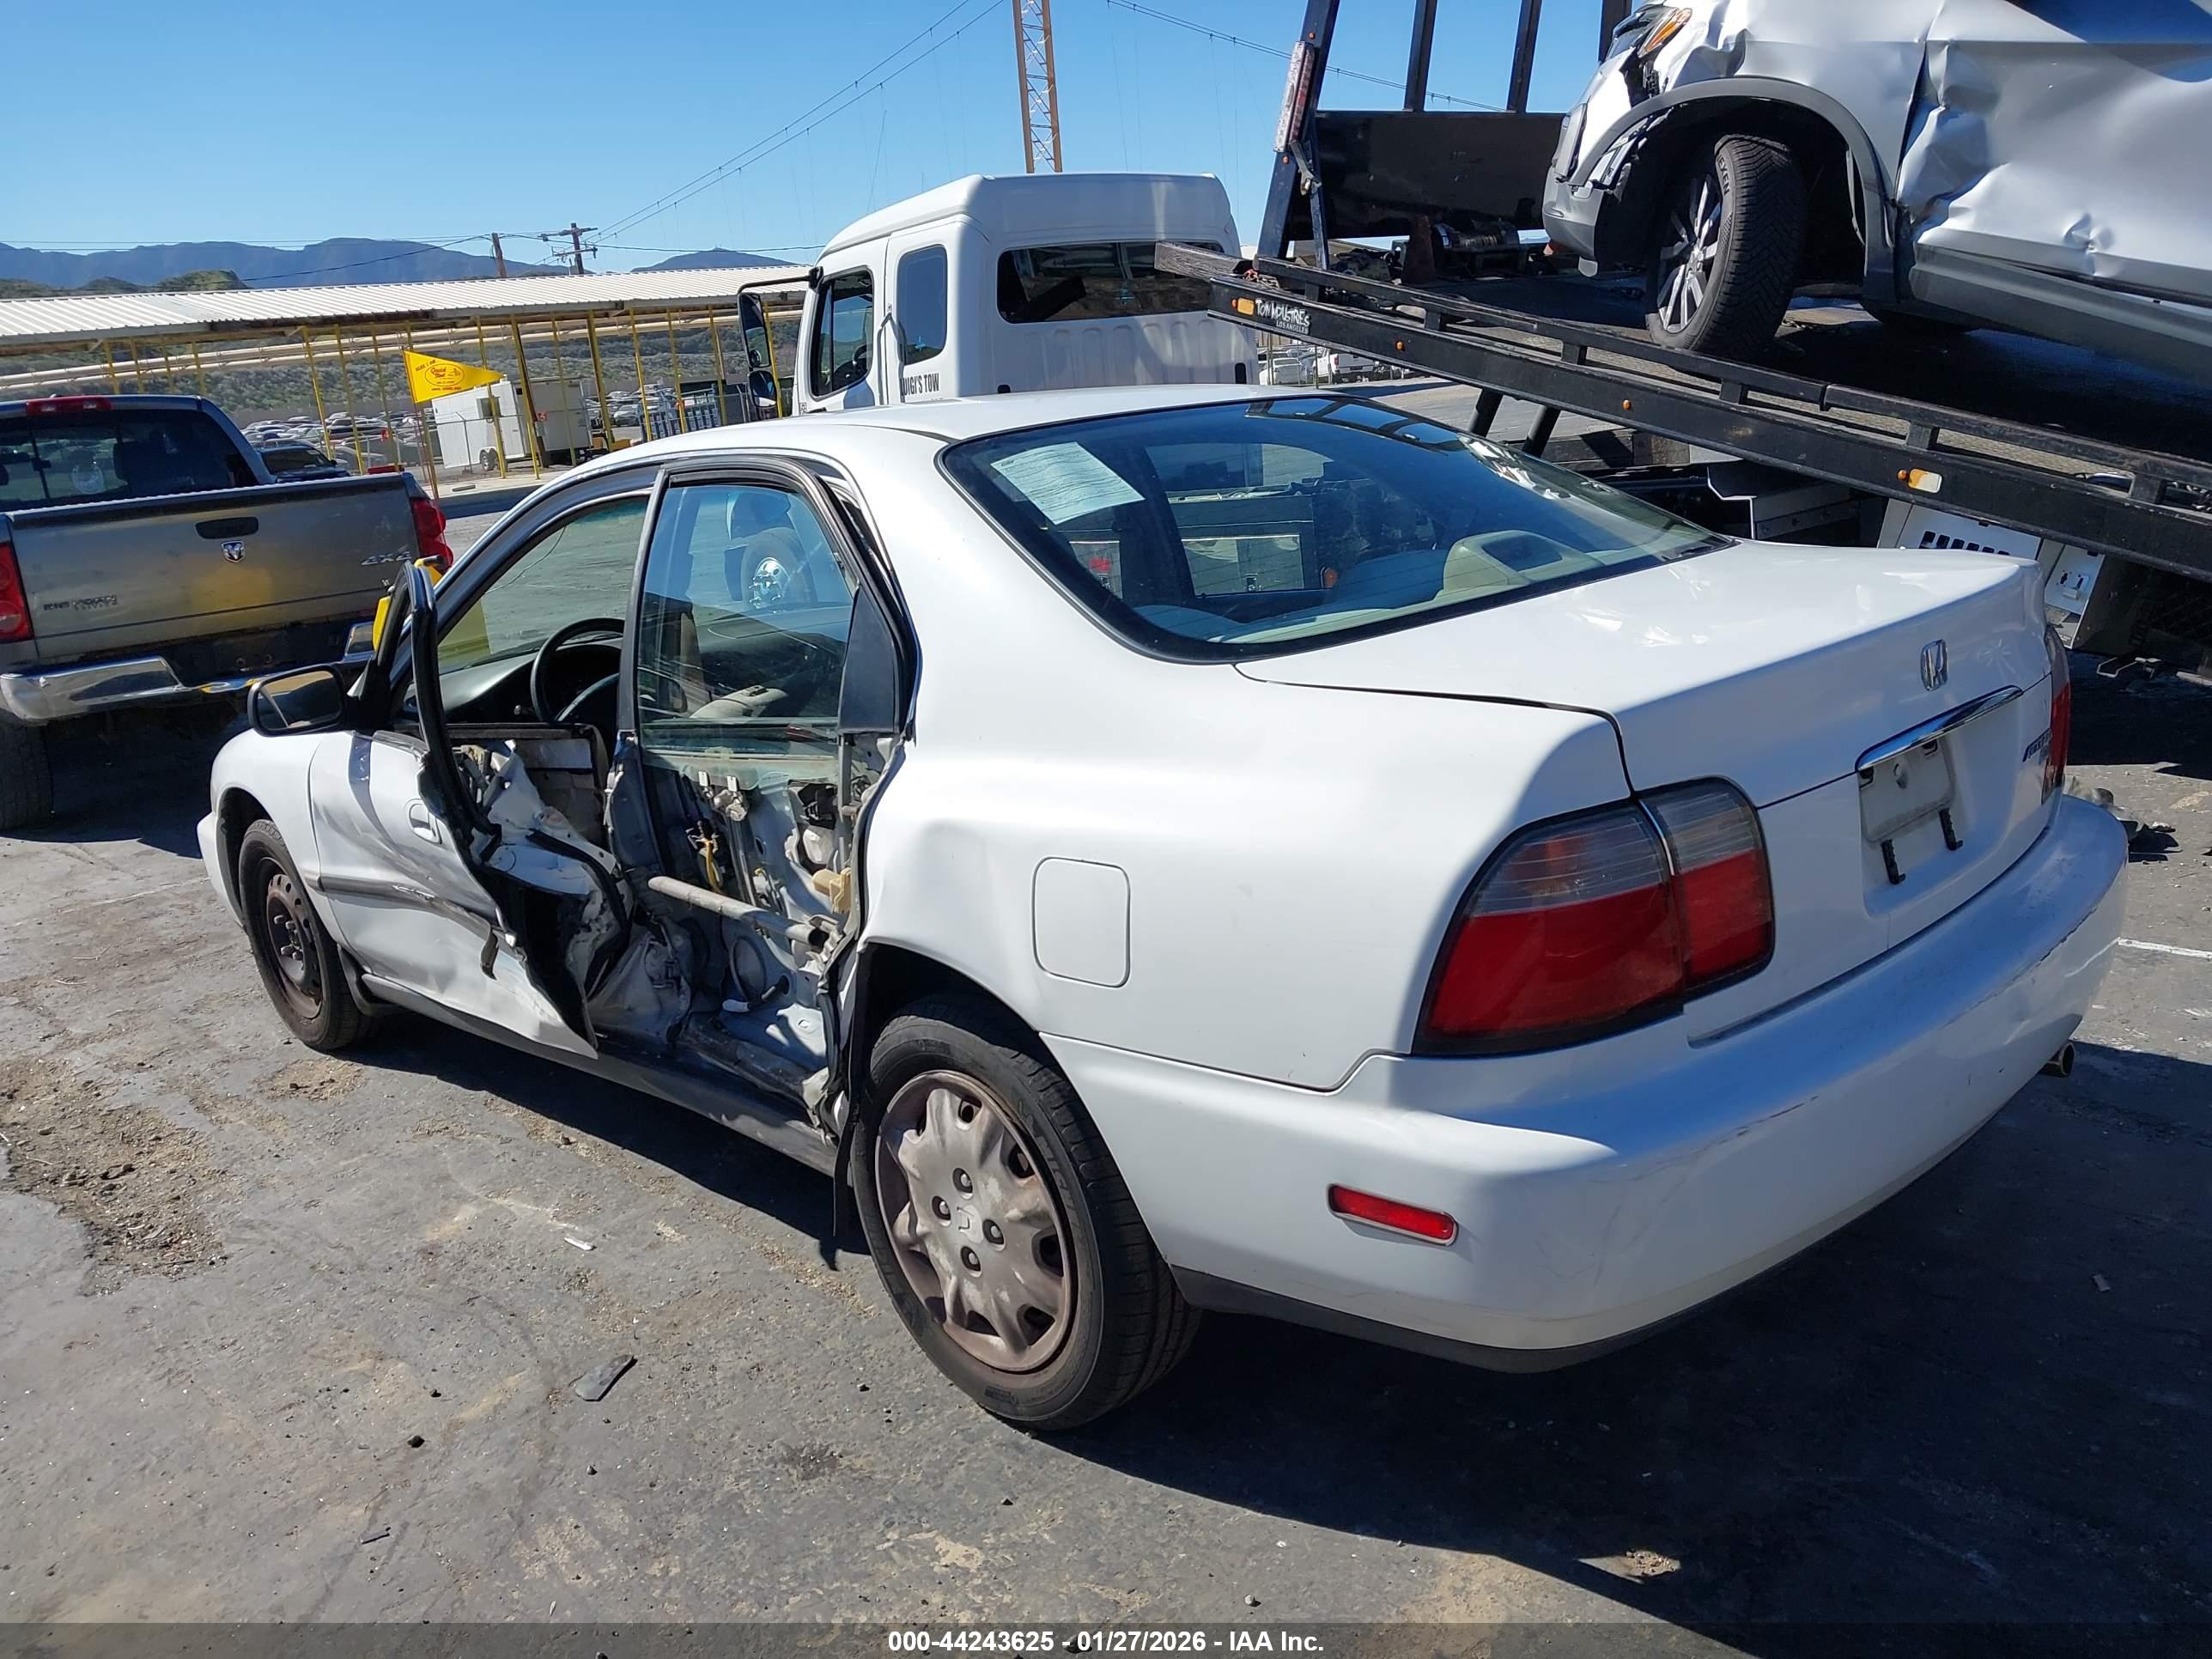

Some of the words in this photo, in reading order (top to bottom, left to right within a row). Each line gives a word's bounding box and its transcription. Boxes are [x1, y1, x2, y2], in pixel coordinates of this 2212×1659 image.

[1276, 320, 1286, 329] LOS
[1285, 322, 1310, 334] ANGELES
[924, 373, 939, 393] TOW
